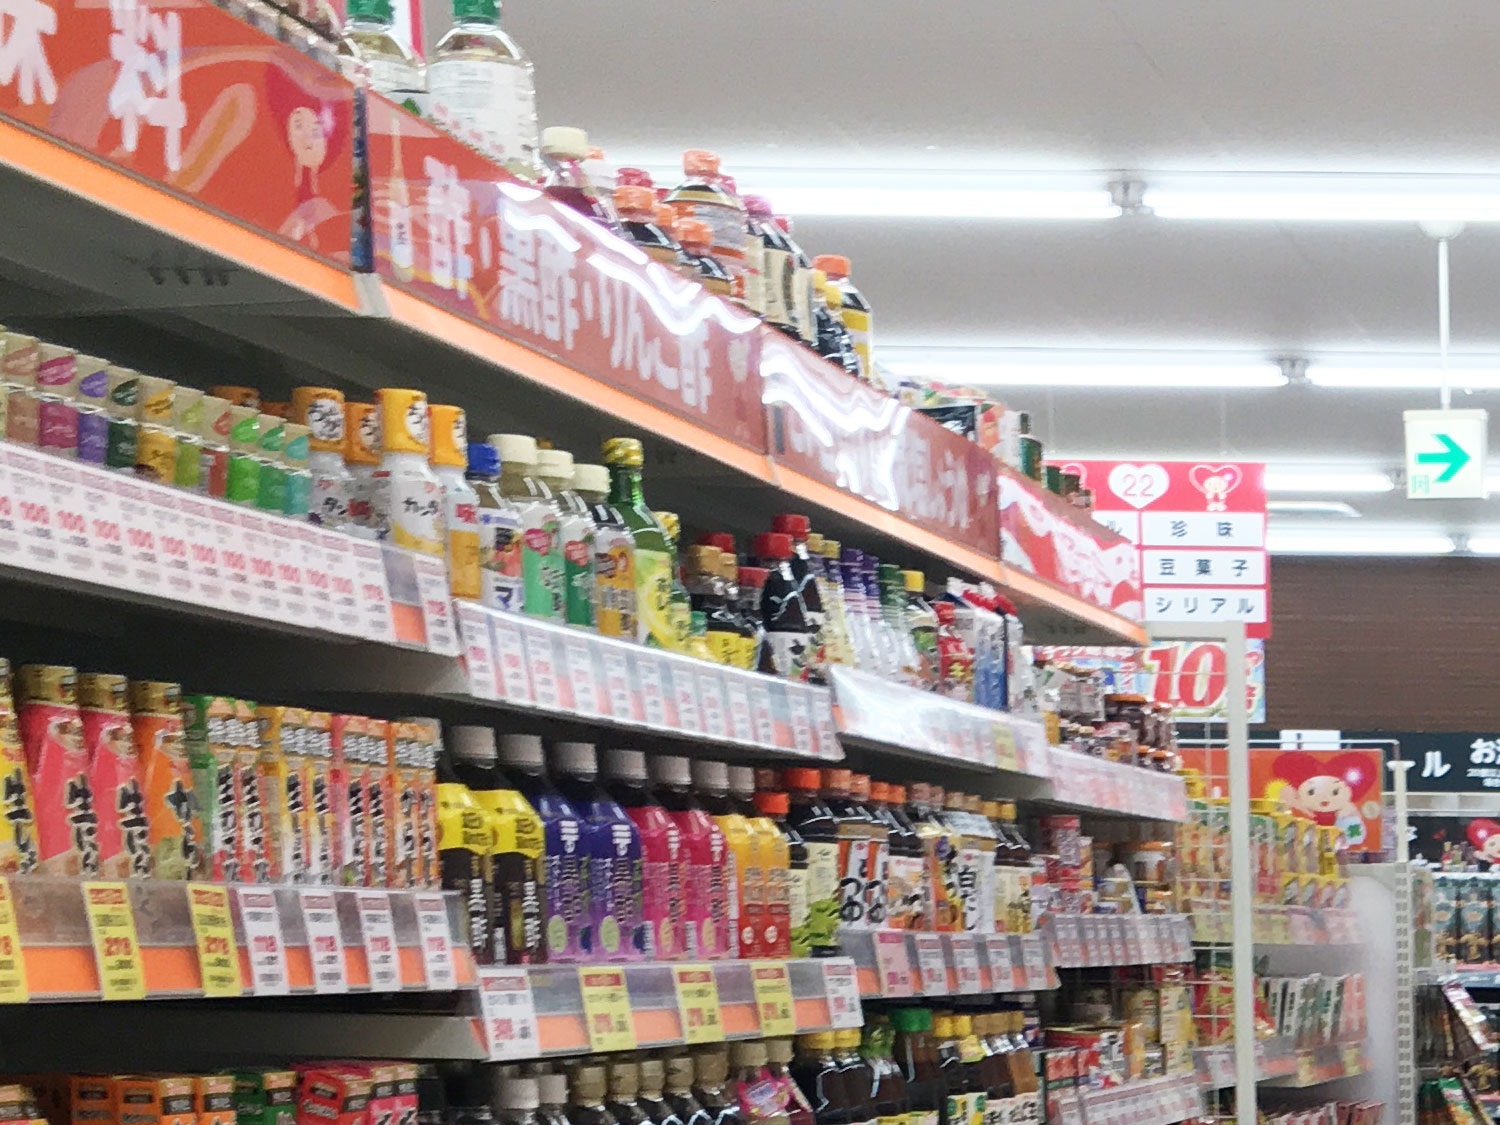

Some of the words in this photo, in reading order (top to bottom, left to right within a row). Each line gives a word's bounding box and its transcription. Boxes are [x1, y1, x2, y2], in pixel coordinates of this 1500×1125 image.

[1121, 474, 1154, 497] 22
[1159, 558, 1249, 577] 豆菓子
[1156, 597, 1254, 614] シリアル
[1151, 644, 1227, 708] 10
